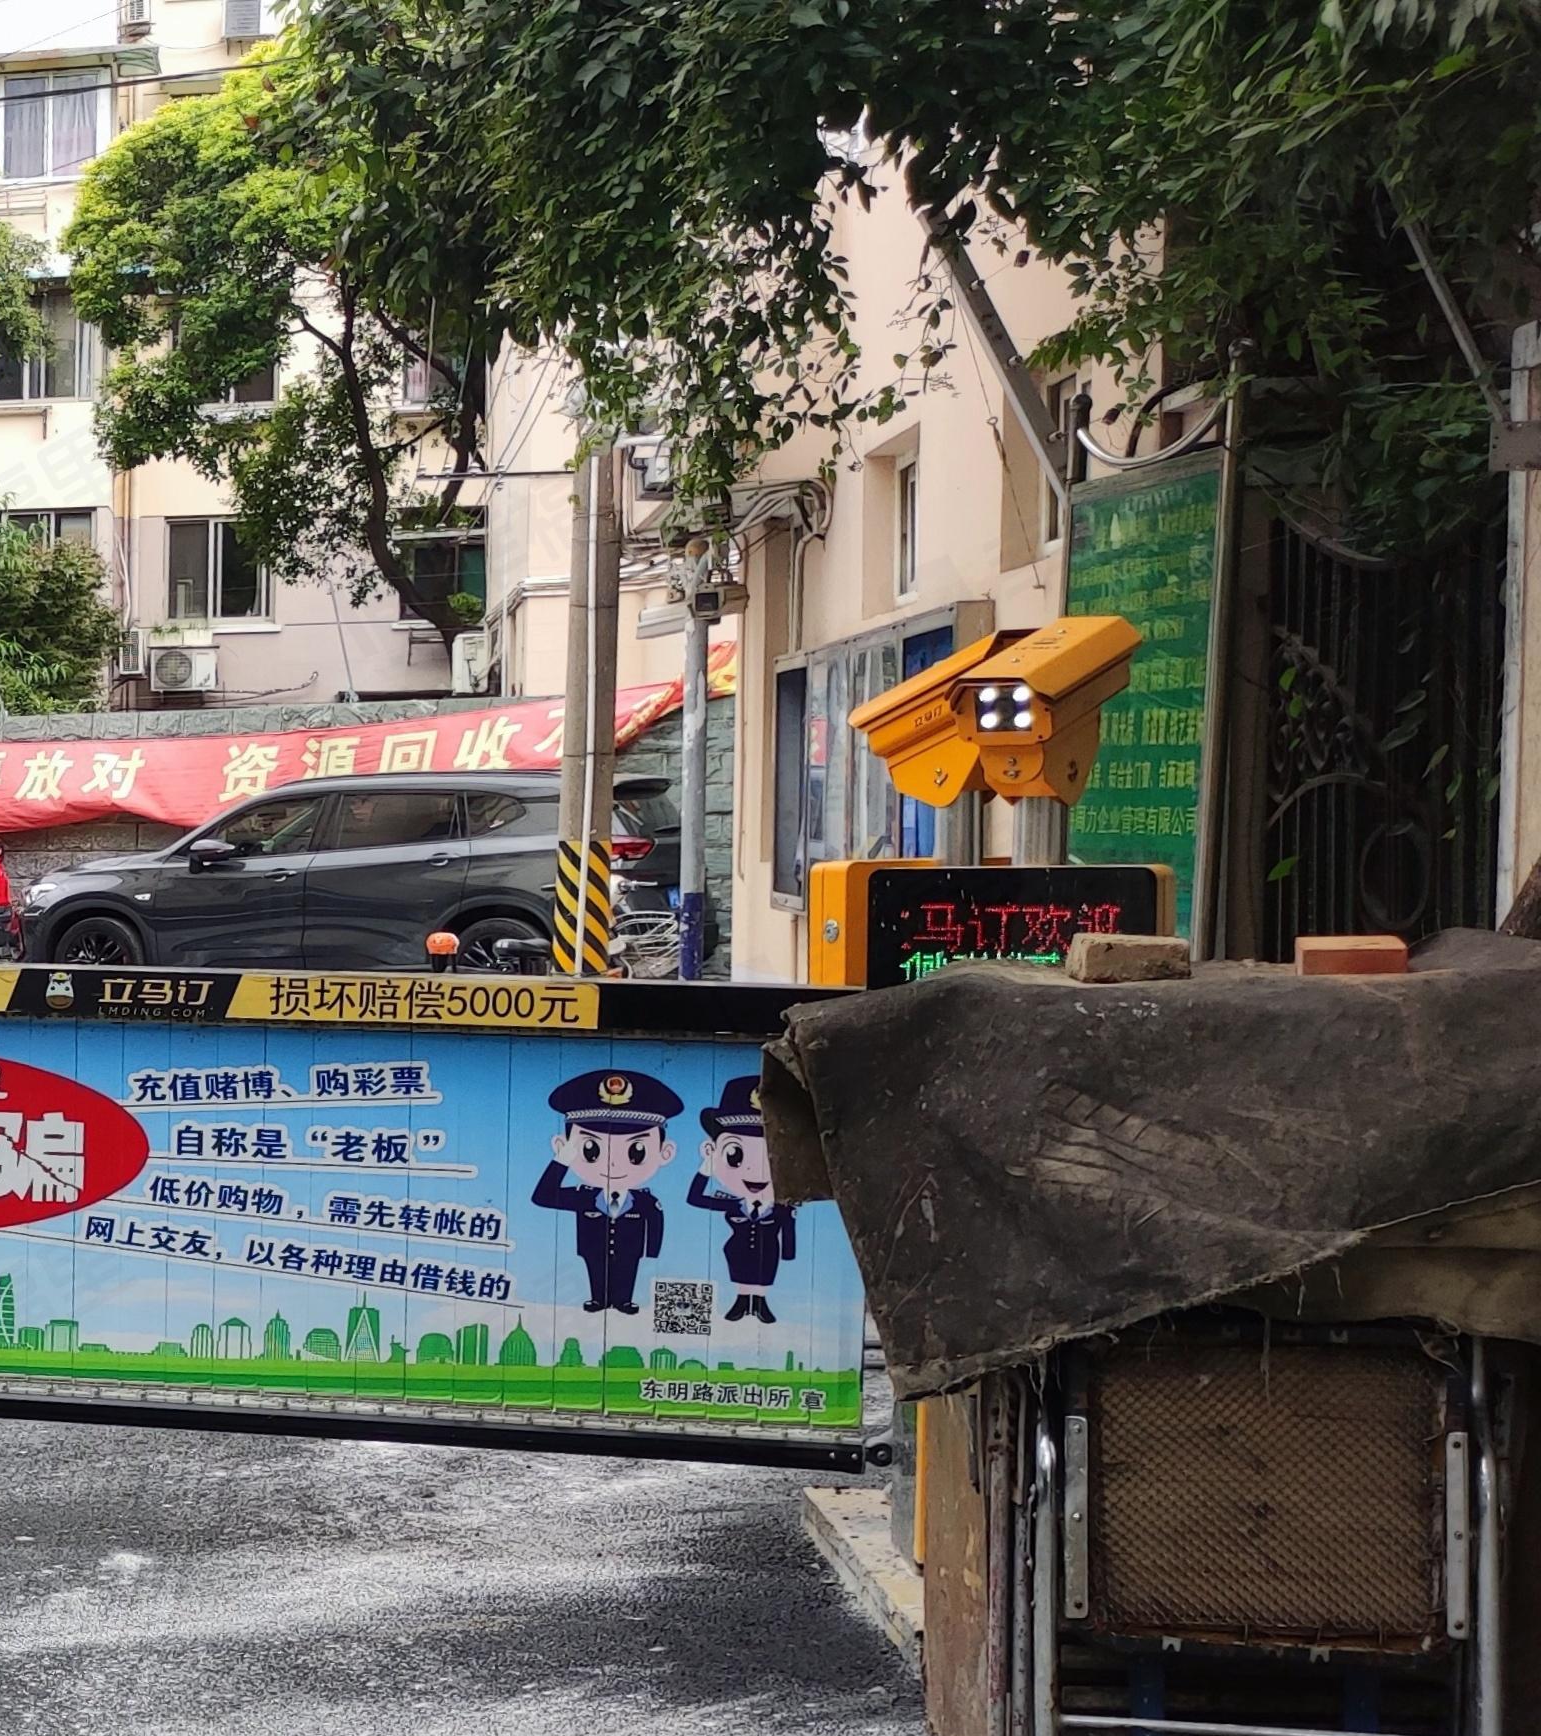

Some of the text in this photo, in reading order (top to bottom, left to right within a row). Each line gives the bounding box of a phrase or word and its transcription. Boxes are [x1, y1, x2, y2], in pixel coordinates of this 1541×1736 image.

[98, 978, 214, 1006] 立马订
[268, 977, 581, 1025] 损坏赔偿5000元
[132, 1064, 428, 1103] 充值赌博、购彩票
[85, 1215, 512, 1300] 网上交友，以各种理由借钱的
[640, 1378, 827, 1411] 东明路派出所 宣
